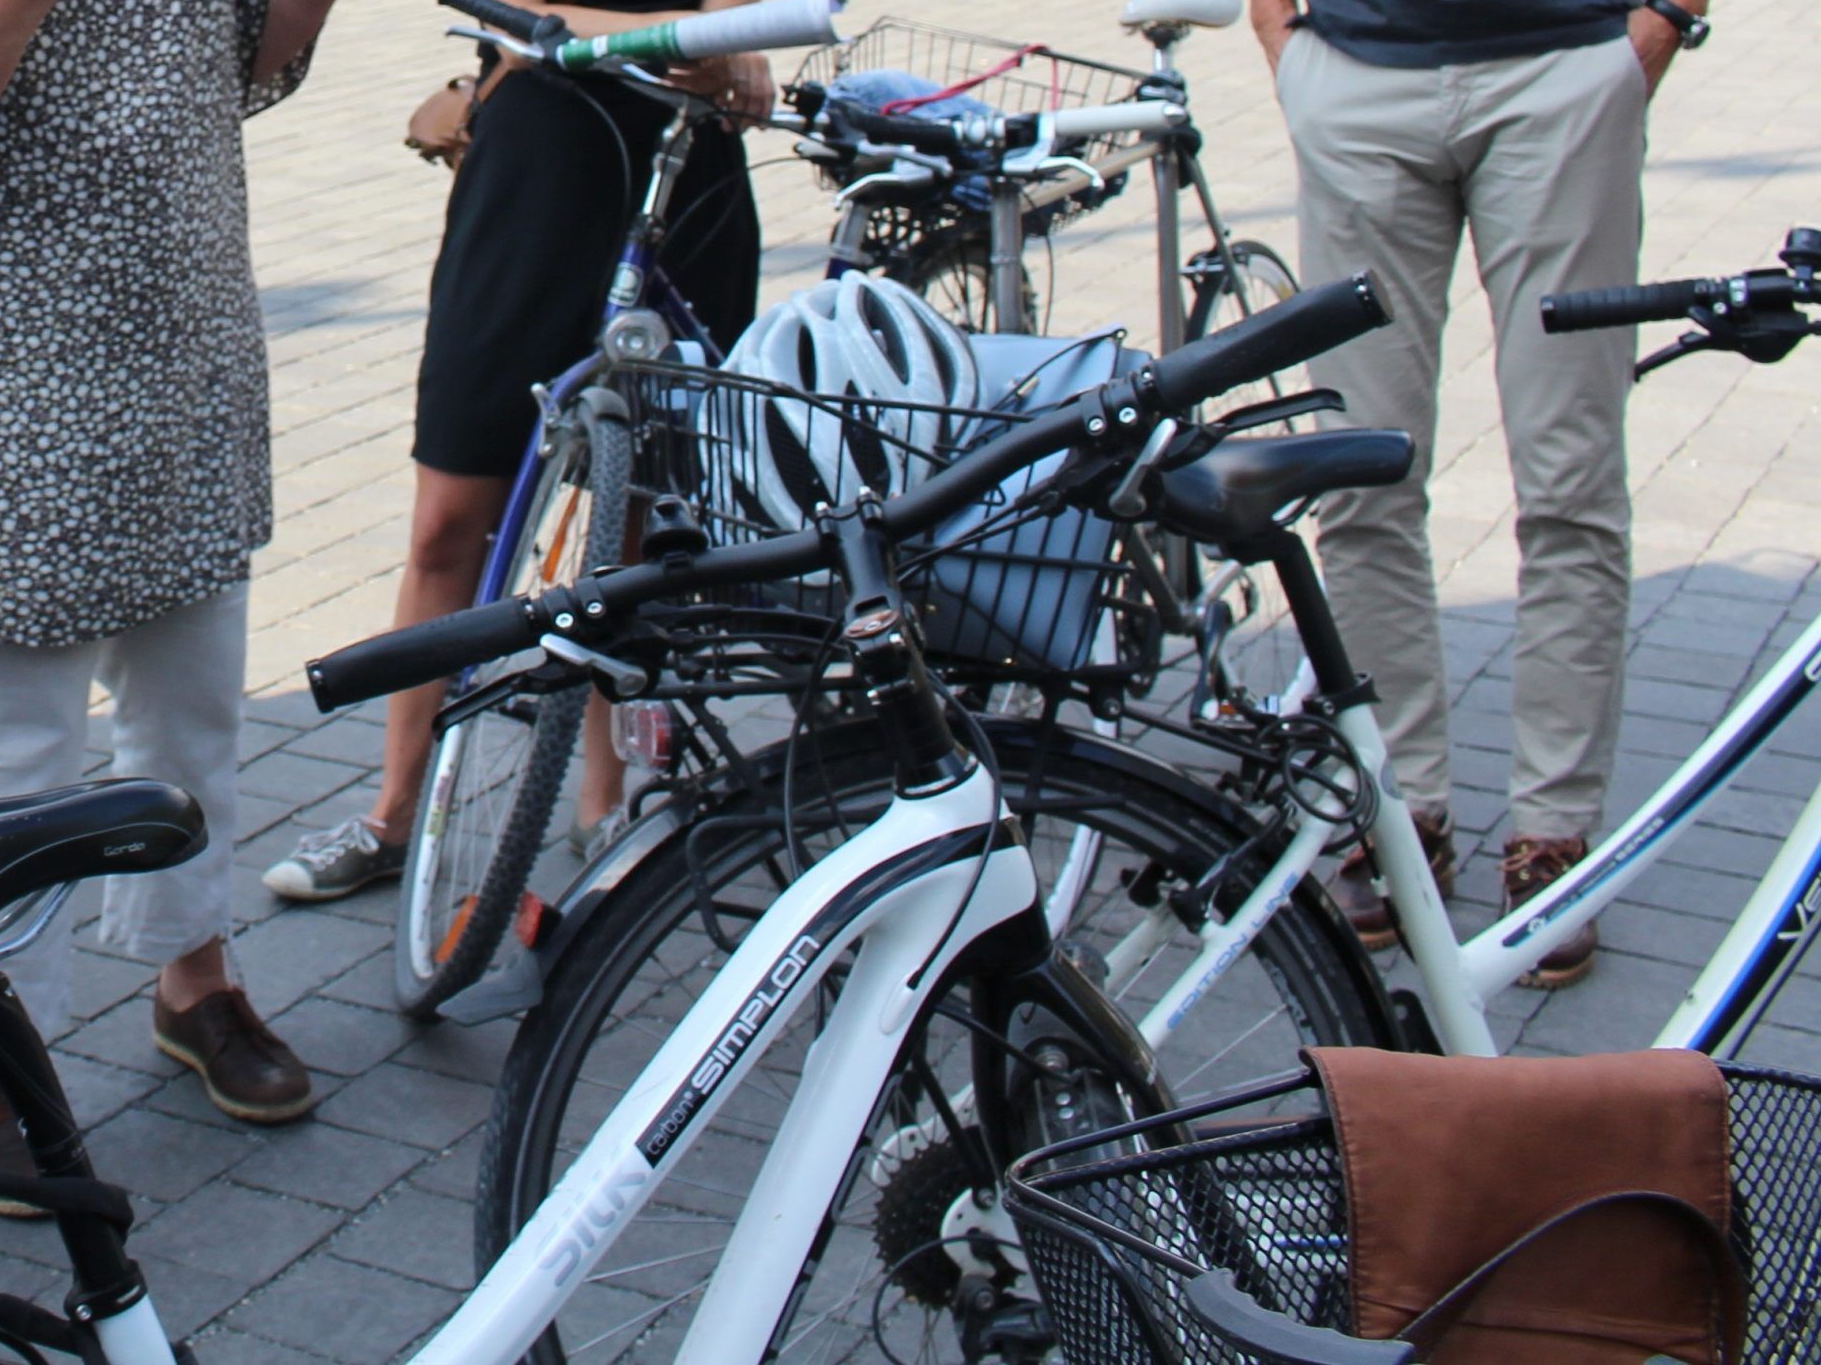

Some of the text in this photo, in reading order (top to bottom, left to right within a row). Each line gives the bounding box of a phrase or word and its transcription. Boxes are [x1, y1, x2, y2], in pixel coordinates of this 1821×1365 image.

[1251, 871, 1298, 929] LINE
[1778, 874, 1821, 940] VE
[691, 934, 820, 1095] SIMPLON
